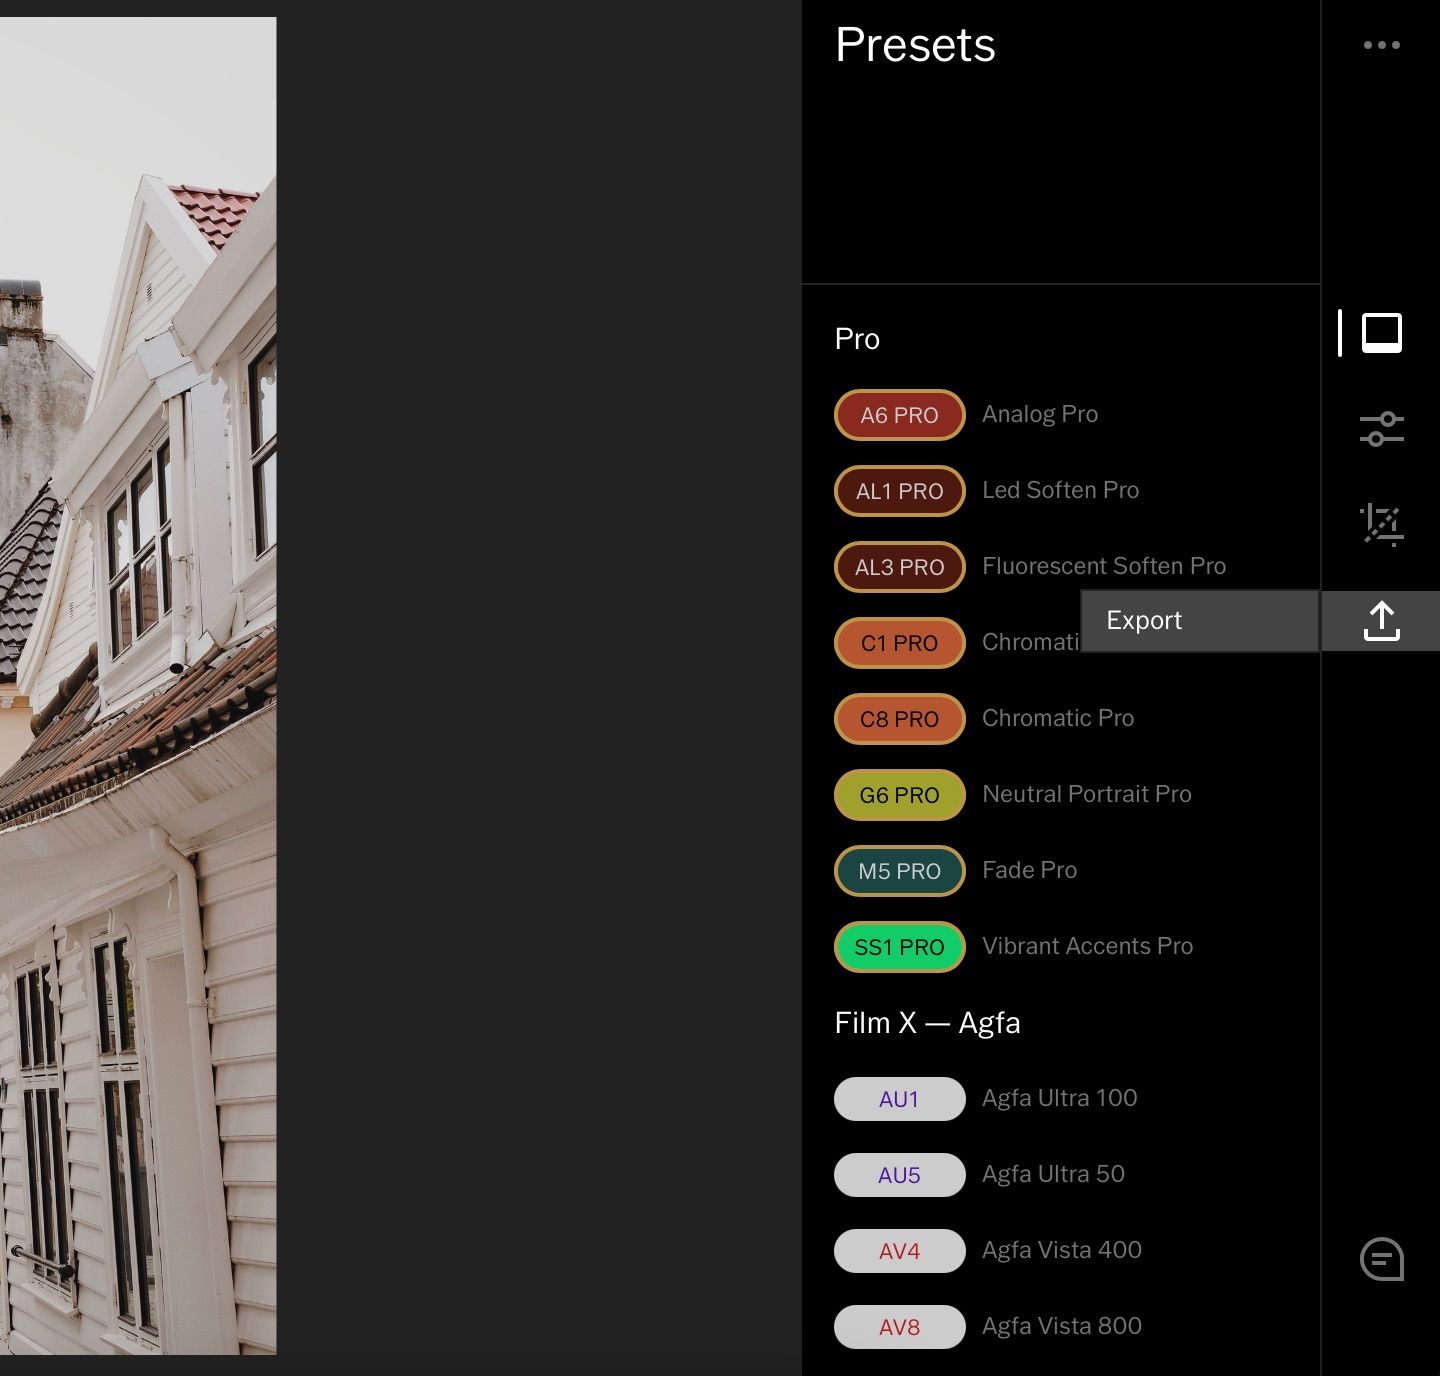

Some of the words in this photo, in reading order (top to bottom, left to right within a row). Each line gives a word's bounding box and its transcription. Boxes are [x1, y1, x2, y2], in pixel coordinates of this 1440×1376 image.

[837, 26, 996, 63] Presets
[835, 326, 880, 351] Pro
[860, 406, 888, 424] A6
[894, 406, 939, 424] PRO
[981, 404, 1057, 428] Analog
[1062, 404, 1099, 423] Pro
[855, 482, 890, 500] AL1
[899, 482, 944, 500] PRO
[983, 480, 1020, 499] Led
[1026, 479, 1097, 499] Soften
[1104, 480, 1140, 499] Pro
[854, 558, 894, 576] AL3
[900, 558, 945, 576] PRO
[983, 556, 1108, 575] Fluorescent
[1113, 556, 1183, 576] Soften
[1191, 556, 1227, 575] Pro
[1107, 609, 1183, 635] Export
[861, 634, 885, 652] C1
[894, 634, 938, 652] PRO
[982, 632, 1079, 651] Chromati
[860, 710, 889, 728] C8
[895, 710, 939, 728] PRO
[982, 708, 1092, 727] Chromatic
[1099, 708, 1135, 727] Pro
[859, 786, 889, 804] G6
[895, 786, 940, 804] PRO
[983, 784, 1062, 803] Neutral
[1069, 784, 1150, 803] Portrait
[1155, 784, 1192, 803] Pro
[859, 862, 891, 880] M5
[897, 862, 941, 880] PRO
[983, 860, 1035, 880] Fade
[1041, 860, 1078, 879] Pro
[854, 938, 891, 956] SS1
[900, 938, 945, 956] PRO
[981, 936, 1060, 955] Vibrant
[1065, 936, 1151, 955] Accents
[1158, 936, 1194, 955] Pro
[836, 1010, 890, 1034] Film
[898, 1010, 918, 1034] X
[958, 1010, 1021, 1040] Agfa
[878, 1089, 917, 1108] AU1
[981, 1087, 1032, 1112] Agfa
[1038, 1088, 1090, 1107] Ultra
[1096, 1088, 1138, 1107] 100
[877, 1166, 921, 1184] AU5
[981, 1164, 1032, 1188] Agfa
[1038, 1164, 1090, 1183] Ultra
[1096, 1164, 1125, 1184] 50
[879, 1242, 921, 1260] AV4
[981, 1239, 1032, 1264] Agfa
[1037, 1240, 1092, 1259] Vista
[1097, 1240, 1142, 1259] 400
[878, 1318, 921, 1337] AV8
[981, 1316, 1032, 1340] Agfa
[1037, 1316, 1092, 1335] Vista
[1098, 1316, 1142, 1335] 800
